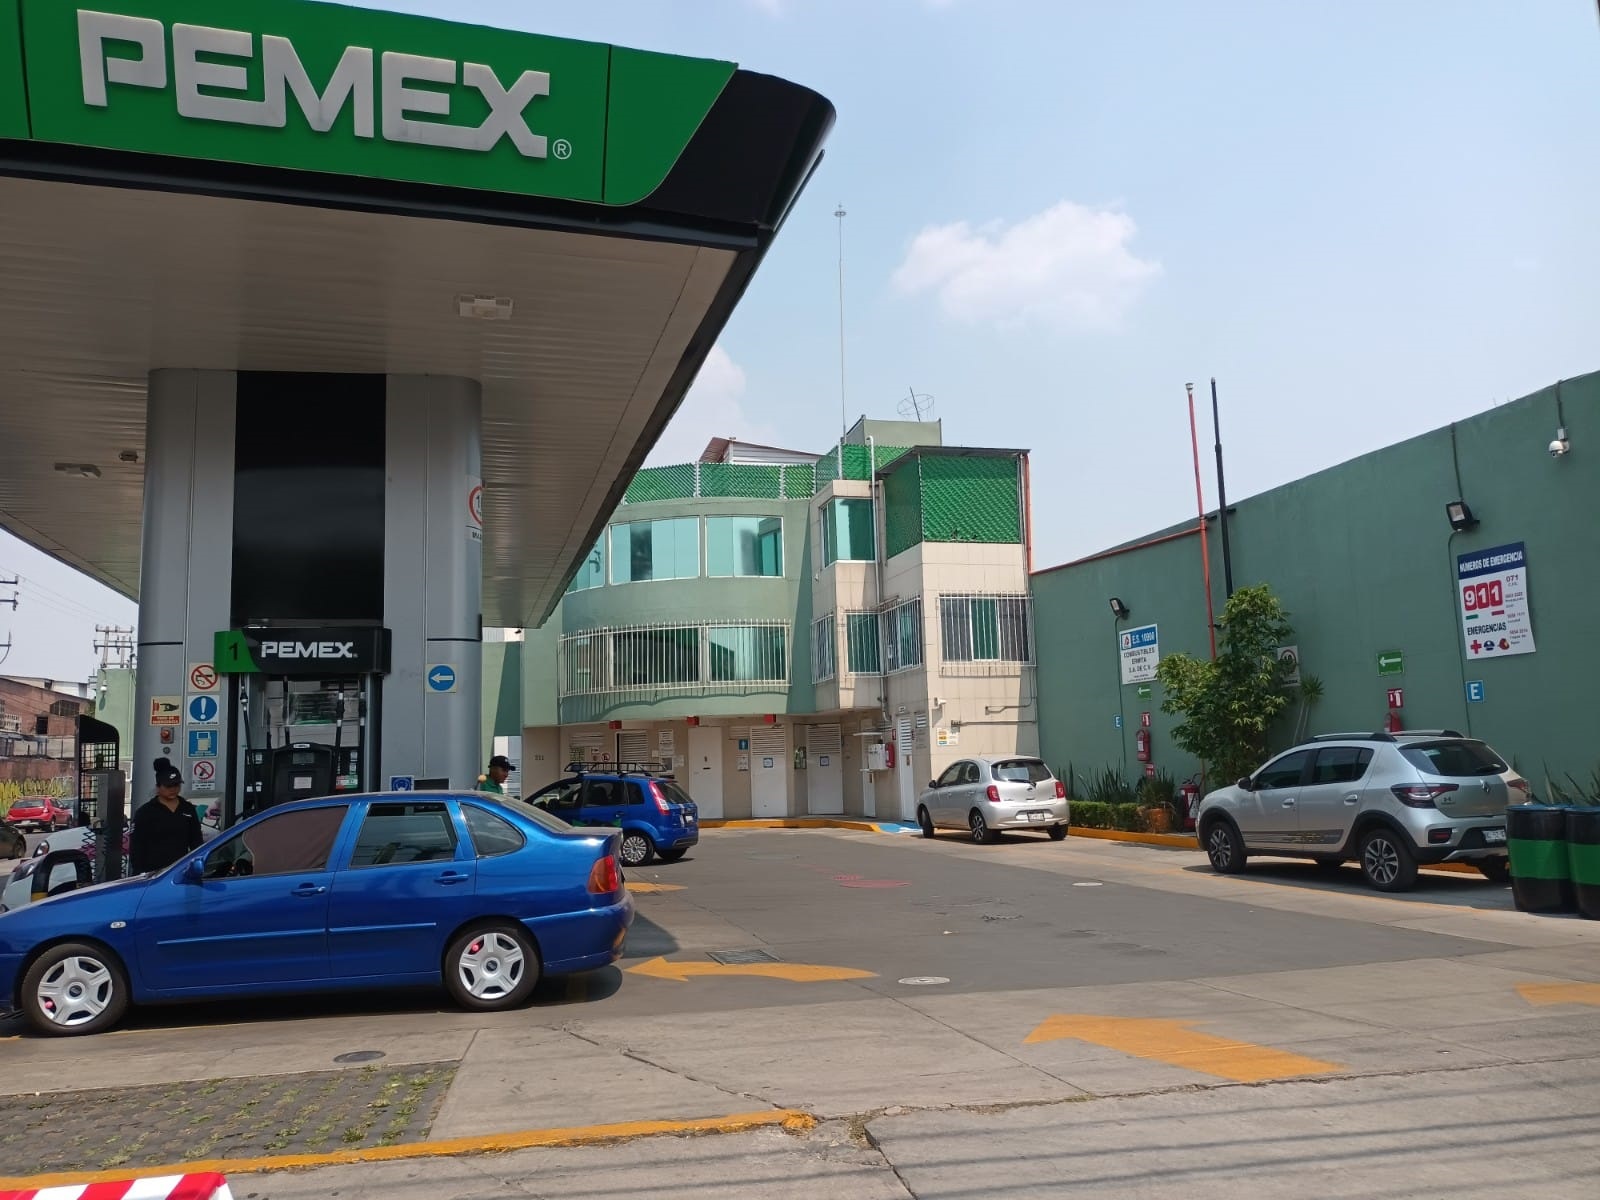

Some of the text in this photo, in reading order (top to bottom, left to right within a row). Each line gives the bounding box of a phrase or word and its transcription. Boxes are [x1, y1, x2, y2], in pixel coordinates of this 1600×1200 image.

[77, 9, 550, 159] PEMEX
[1482, 557, 1490, 568] DE
[1490, 550, 1523, 567] EMERGENCIA
[1464, 584, 1500, 607] 911
[1467, 622, 1507, 636] EMERGENCIAS
[229, 642, 238, 661] 1
[261, 641, 354, 659] PEMEX
[1470, 683, 1481, 700] E
